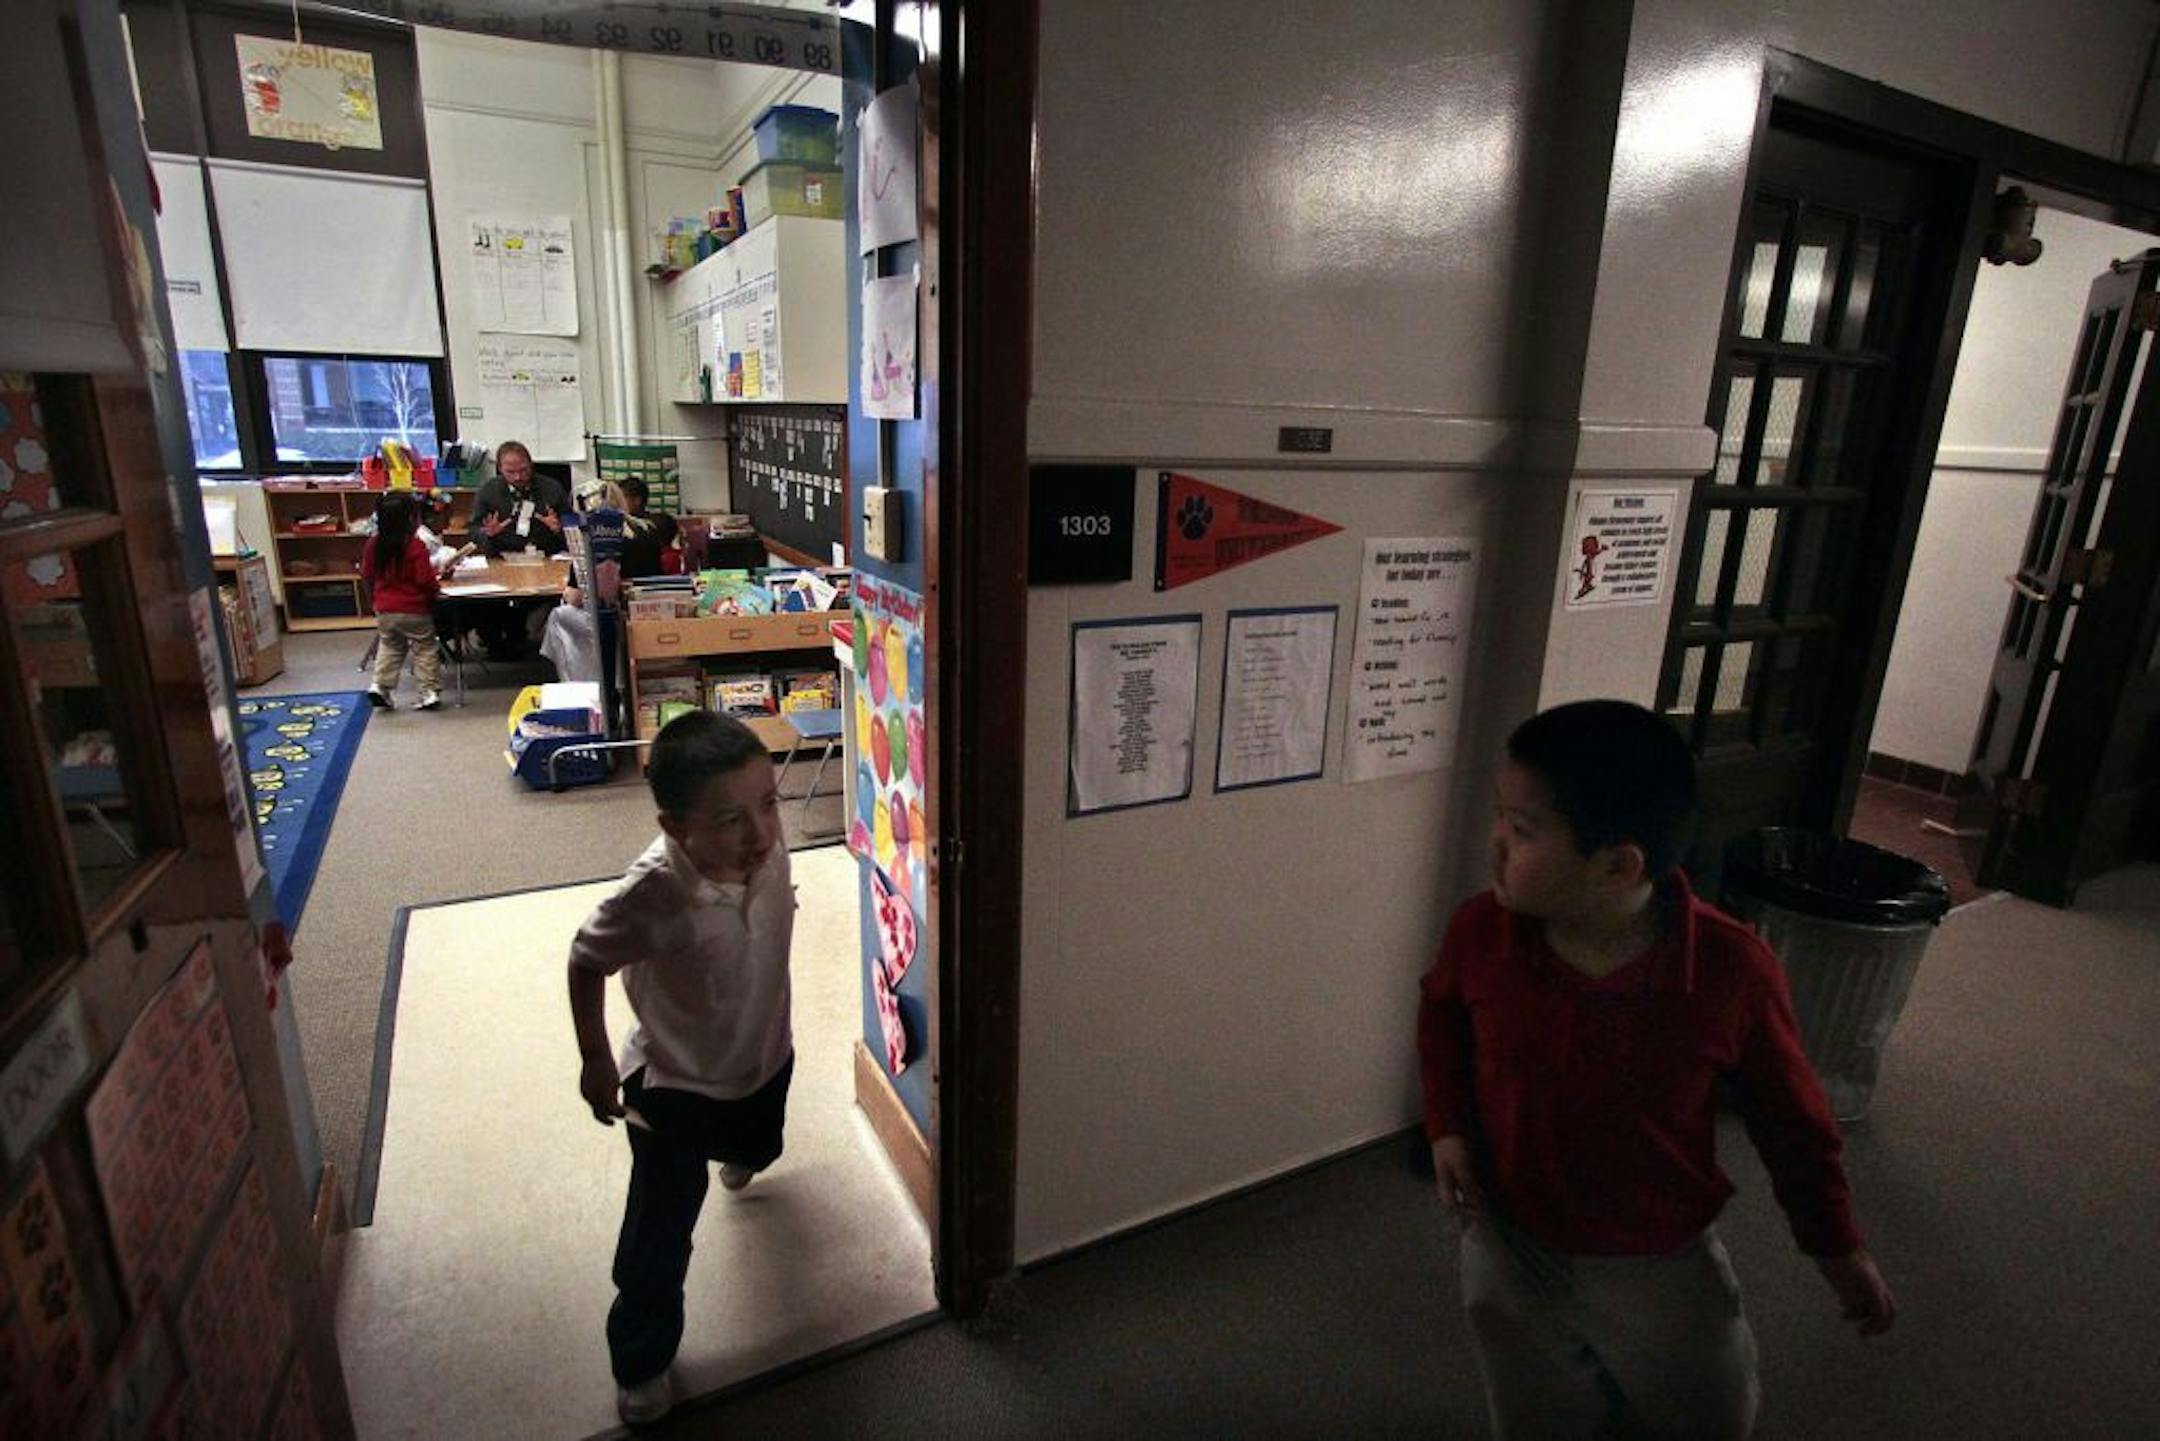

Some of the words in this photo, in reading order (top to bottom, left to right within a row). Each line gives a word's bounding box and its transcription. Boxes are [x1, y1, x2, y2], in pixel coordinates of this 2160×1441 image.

[275, 44, 371, 74] yellow
[1059, 515, 1111, 536] 1303
[1394, 551, 1429, 564] learning
[1401, 568, 1424, 582] today
